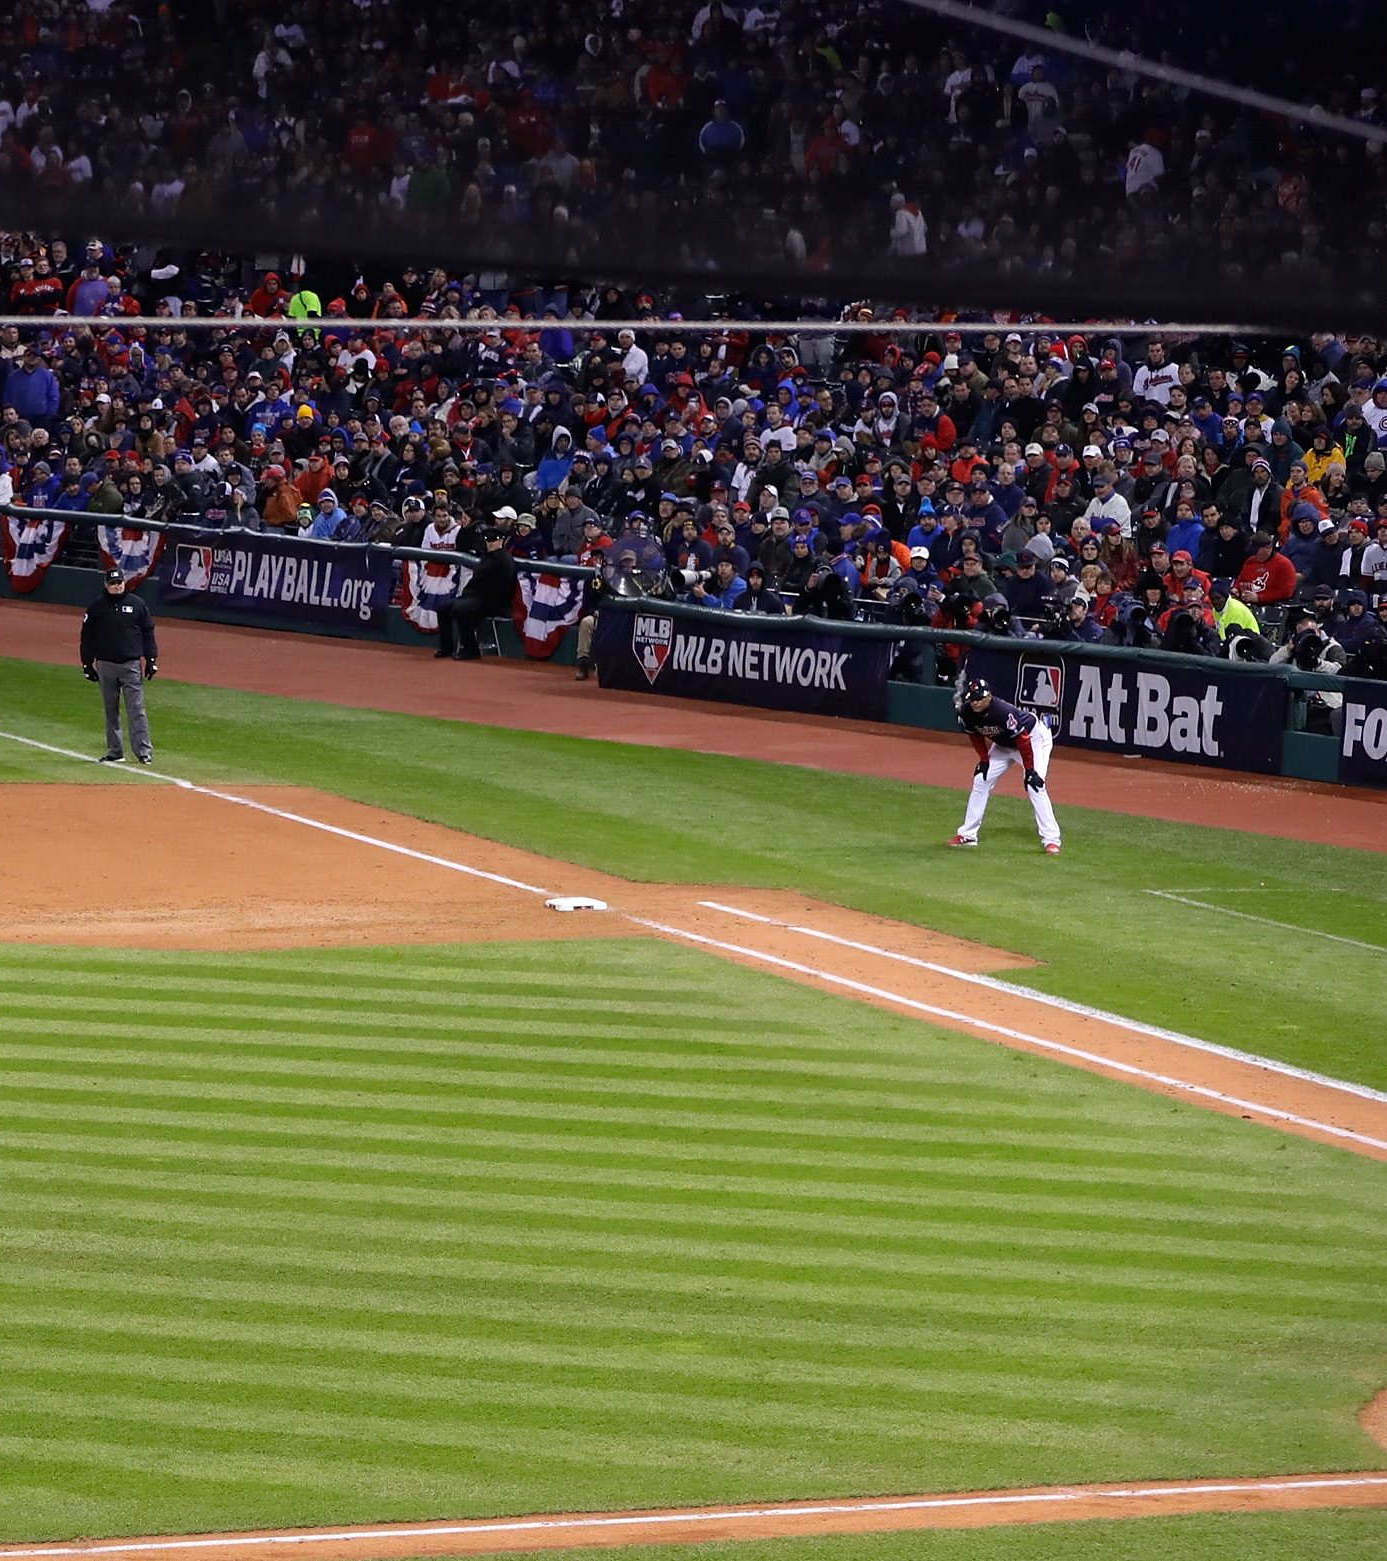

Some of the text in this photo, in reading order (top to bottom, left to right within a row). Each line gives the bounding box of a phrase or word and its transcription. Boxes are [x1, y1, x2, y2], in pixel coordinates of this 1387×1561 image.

[211, 572, 230, 586] USA
[229, 551, 375, 621] PLAYBALL.org
[635, 636, 668, 646] NETWORK
[636, 617, 670, 639] MLB
[673, 634, 847, 691] MLB NETWORK
[1069, 665, 1223, 757] At Bat
[1343, 702, 1387, 762] FO
